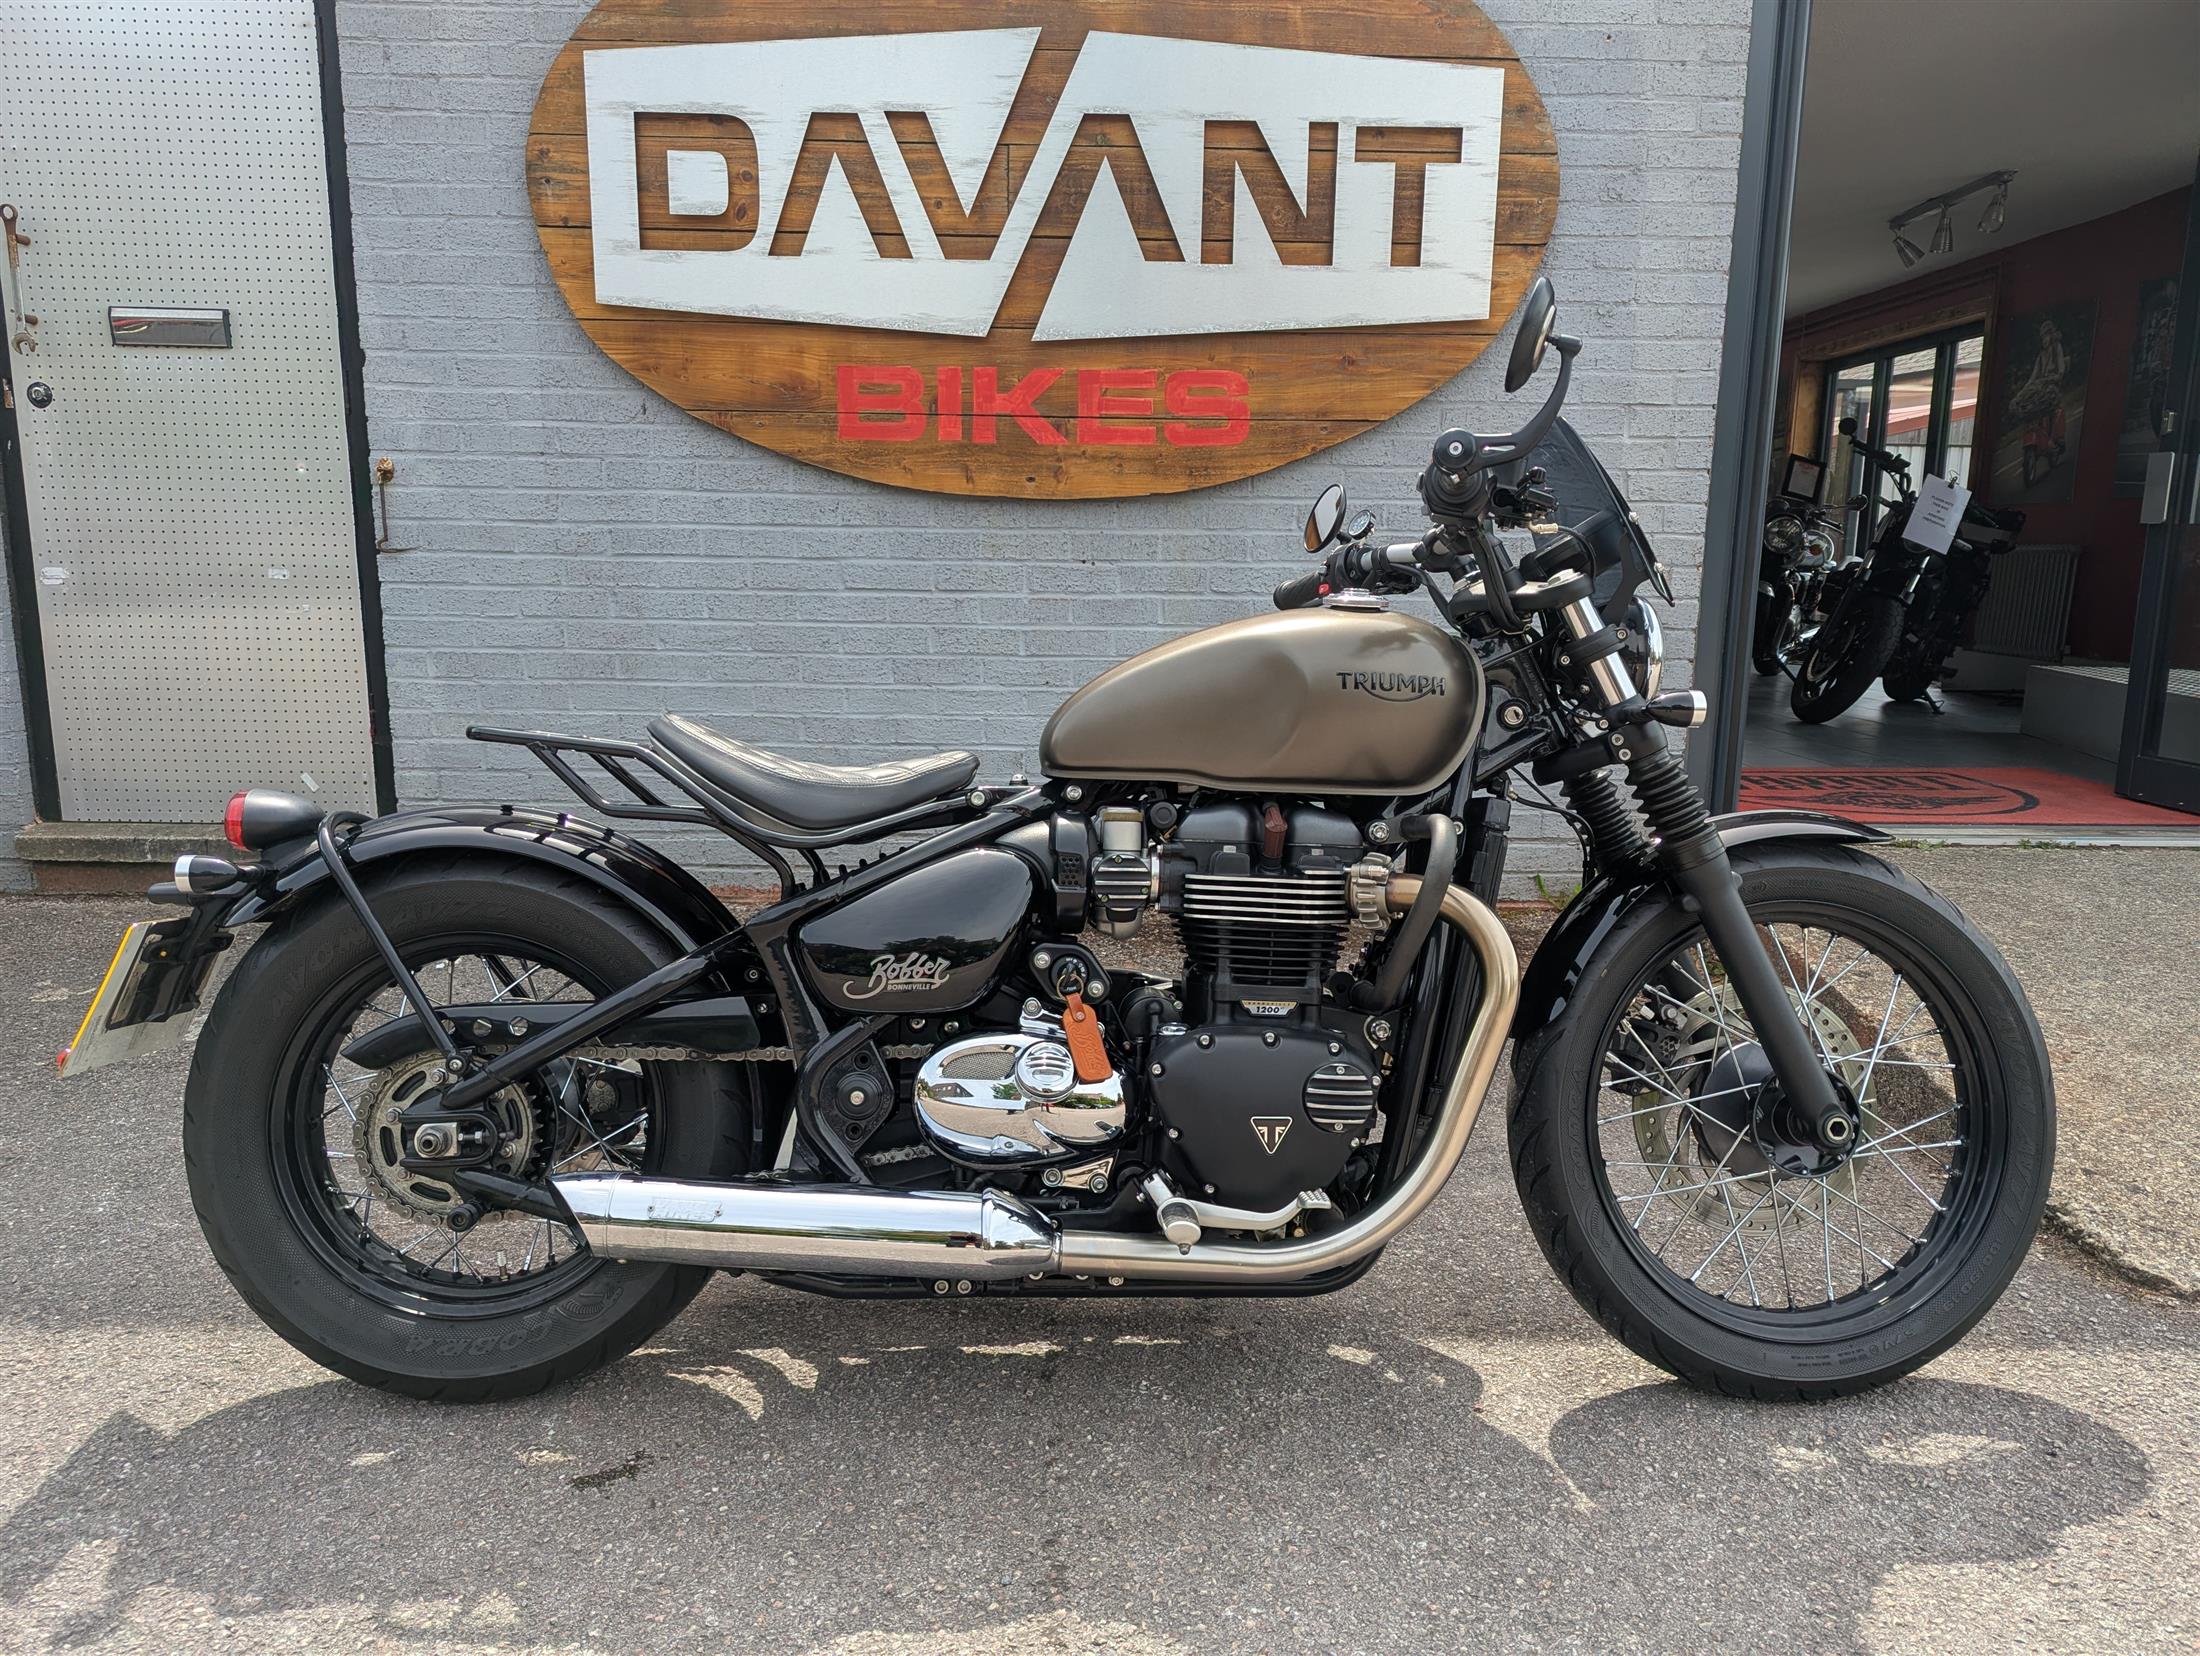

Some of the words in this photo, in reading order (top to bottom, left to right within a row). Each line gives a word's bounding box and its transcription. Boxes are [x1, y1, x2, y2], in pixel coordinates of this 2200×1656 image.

[633, 110, 1463, 267] DAVANT
[837, 364, 1250, 446] BIKES
[1336, 671, 1446, 702] TRIUMPH
[843, 952, 950, 999] Bobber
[887, 983, 931, 991] BONNEVILLE
[1256, 1006, 1280, 1014] 1200
